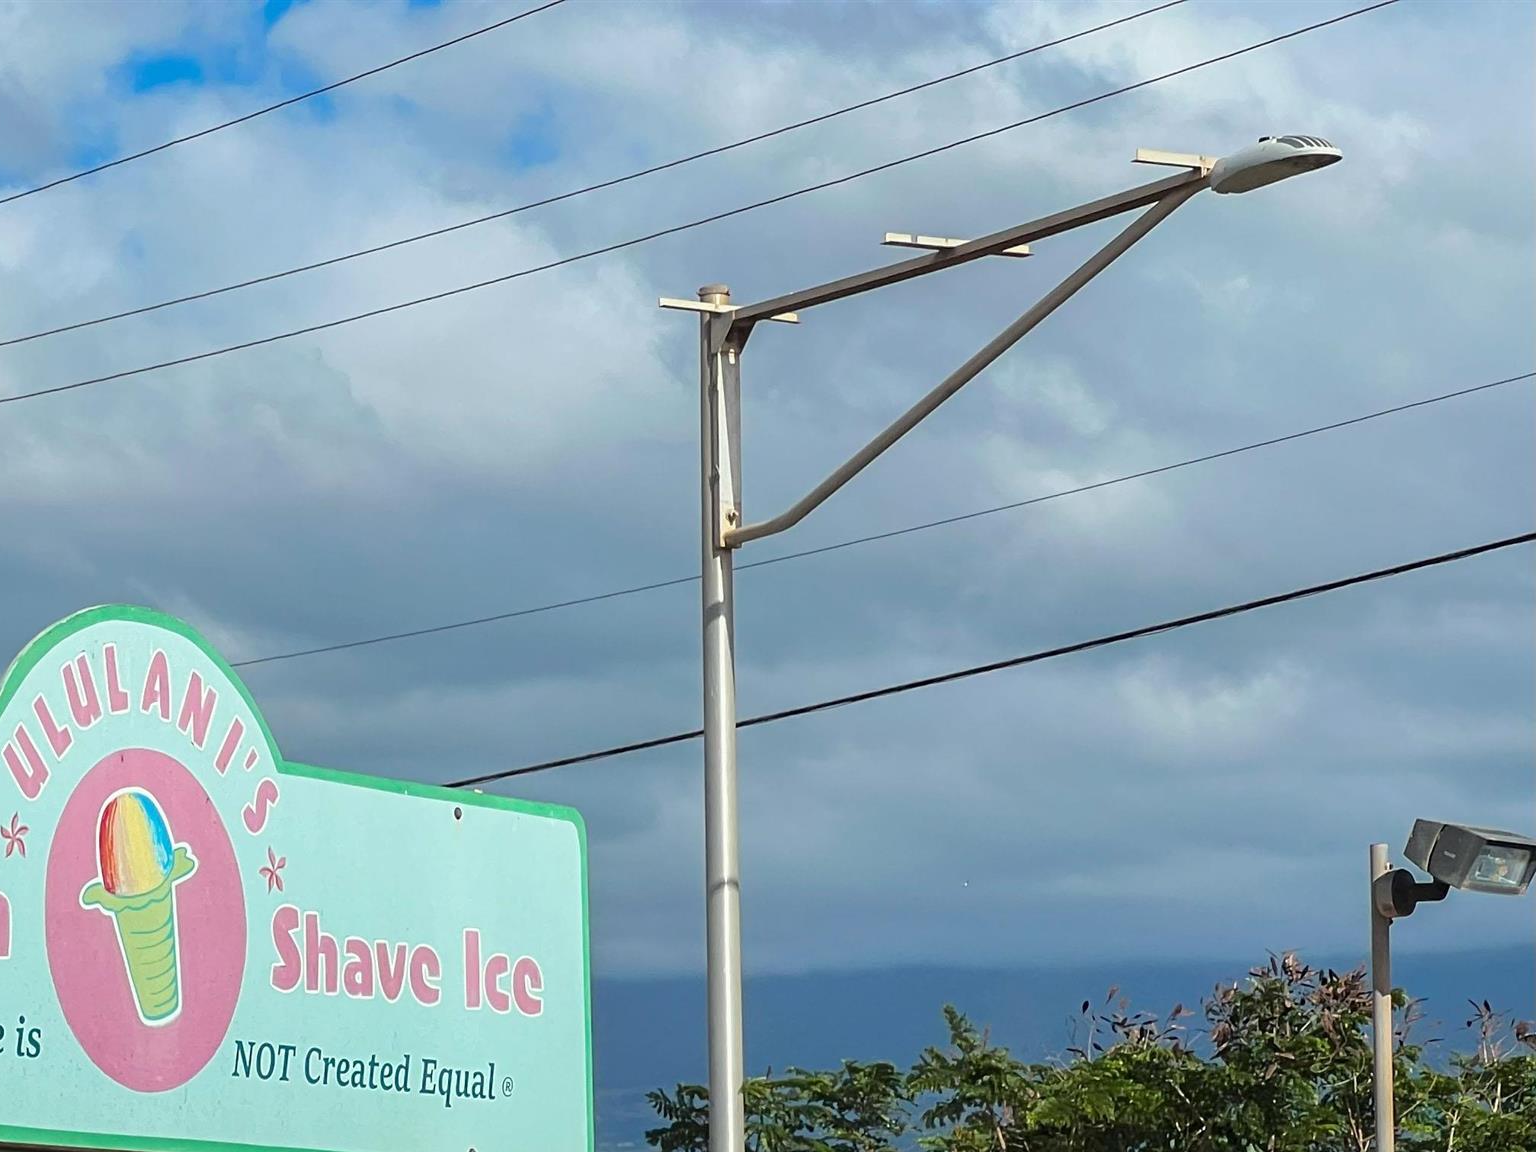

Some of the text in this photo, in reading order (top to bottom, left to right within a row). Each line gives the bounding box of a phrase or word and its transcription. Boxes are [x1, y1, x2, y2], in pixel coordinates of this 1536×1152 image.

[2, 642, 280, 835] ULULANI'S
[271, 904, 544, 1017] Shave Ice
[15, 1015, 42, 1058] is
[231, 1040, 296, 1081] NOT
[304, 1048, 411, 1093] Created
[419, 1058, 495, 1108] Equal
